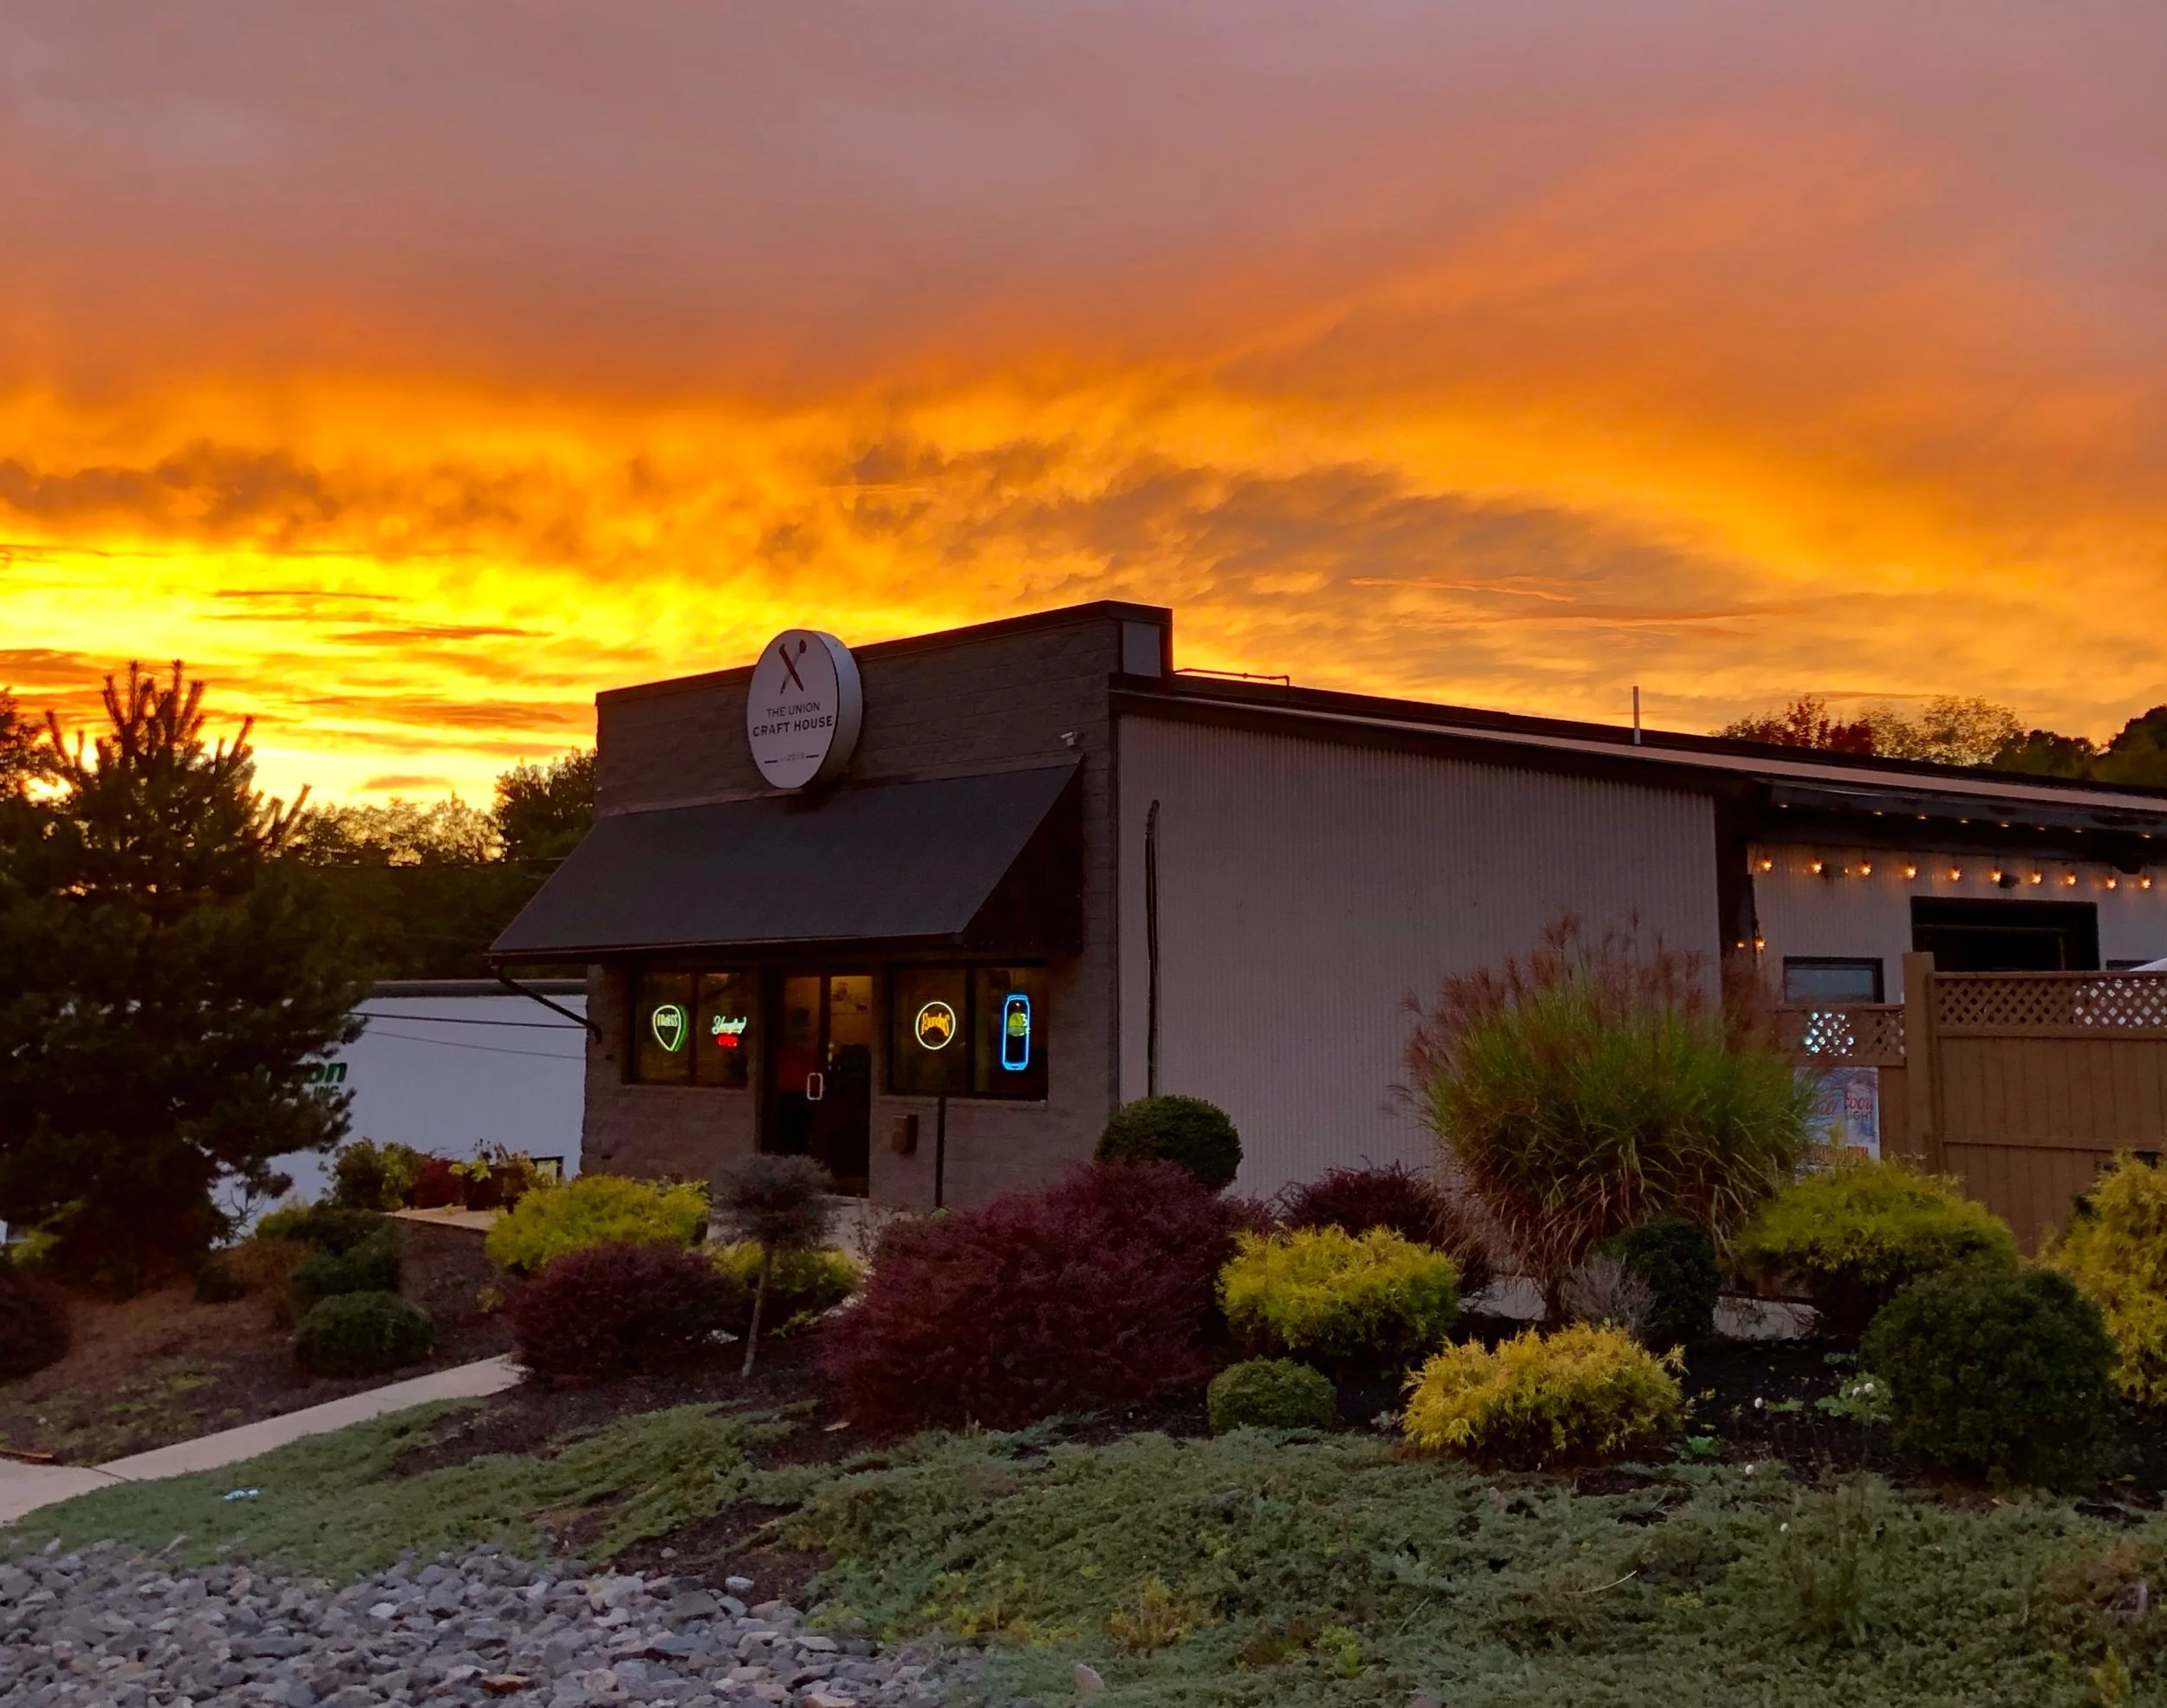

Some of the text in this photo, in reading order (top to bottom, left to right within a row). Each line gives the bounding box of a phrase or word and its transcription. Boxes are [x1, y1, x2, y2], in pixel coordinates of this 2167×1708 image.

[767, 701, 820, 718] THE UNION
[752, 715, 832, 737] CRAFT HOUSE
